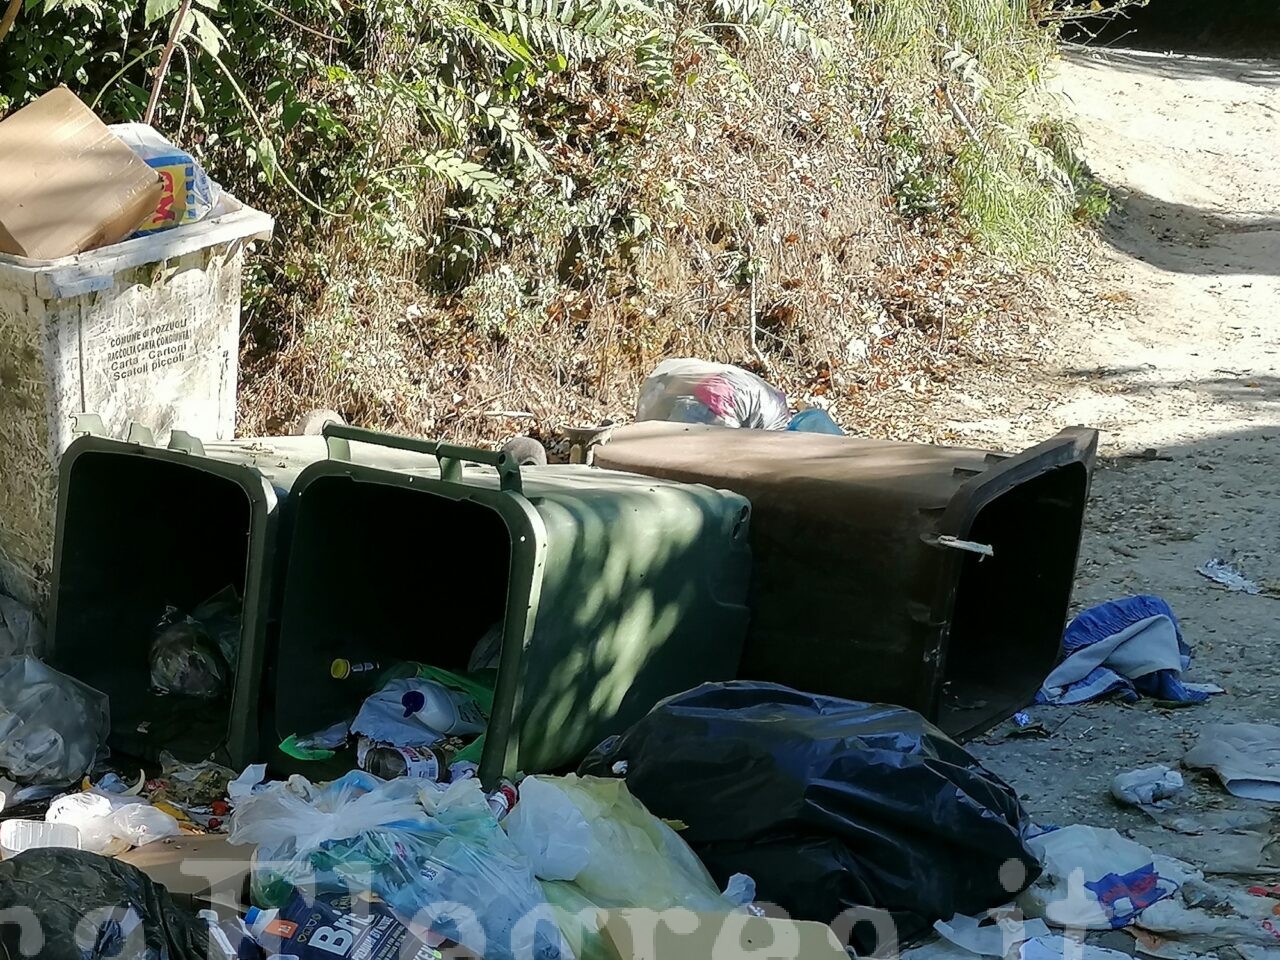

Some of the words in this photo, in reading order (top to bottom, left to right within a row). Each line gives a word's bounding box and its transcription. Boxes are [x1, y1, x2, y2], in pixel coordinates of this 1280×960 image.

[110, 330, 141, 348] COMUNE
[142, 328, 150, 338] di
[151, 318, 187, 336] POZZUOLI
[108, 344, 136, 362] RACCOLTA
[136, 337, 156, 353] CARTA
[110, 356, 139, 371] Carta
[148, 341, 187, 360] Cartoni
[113, 362, 148, 381] Scatoli
[151, 352, 185, 372] piccoli
